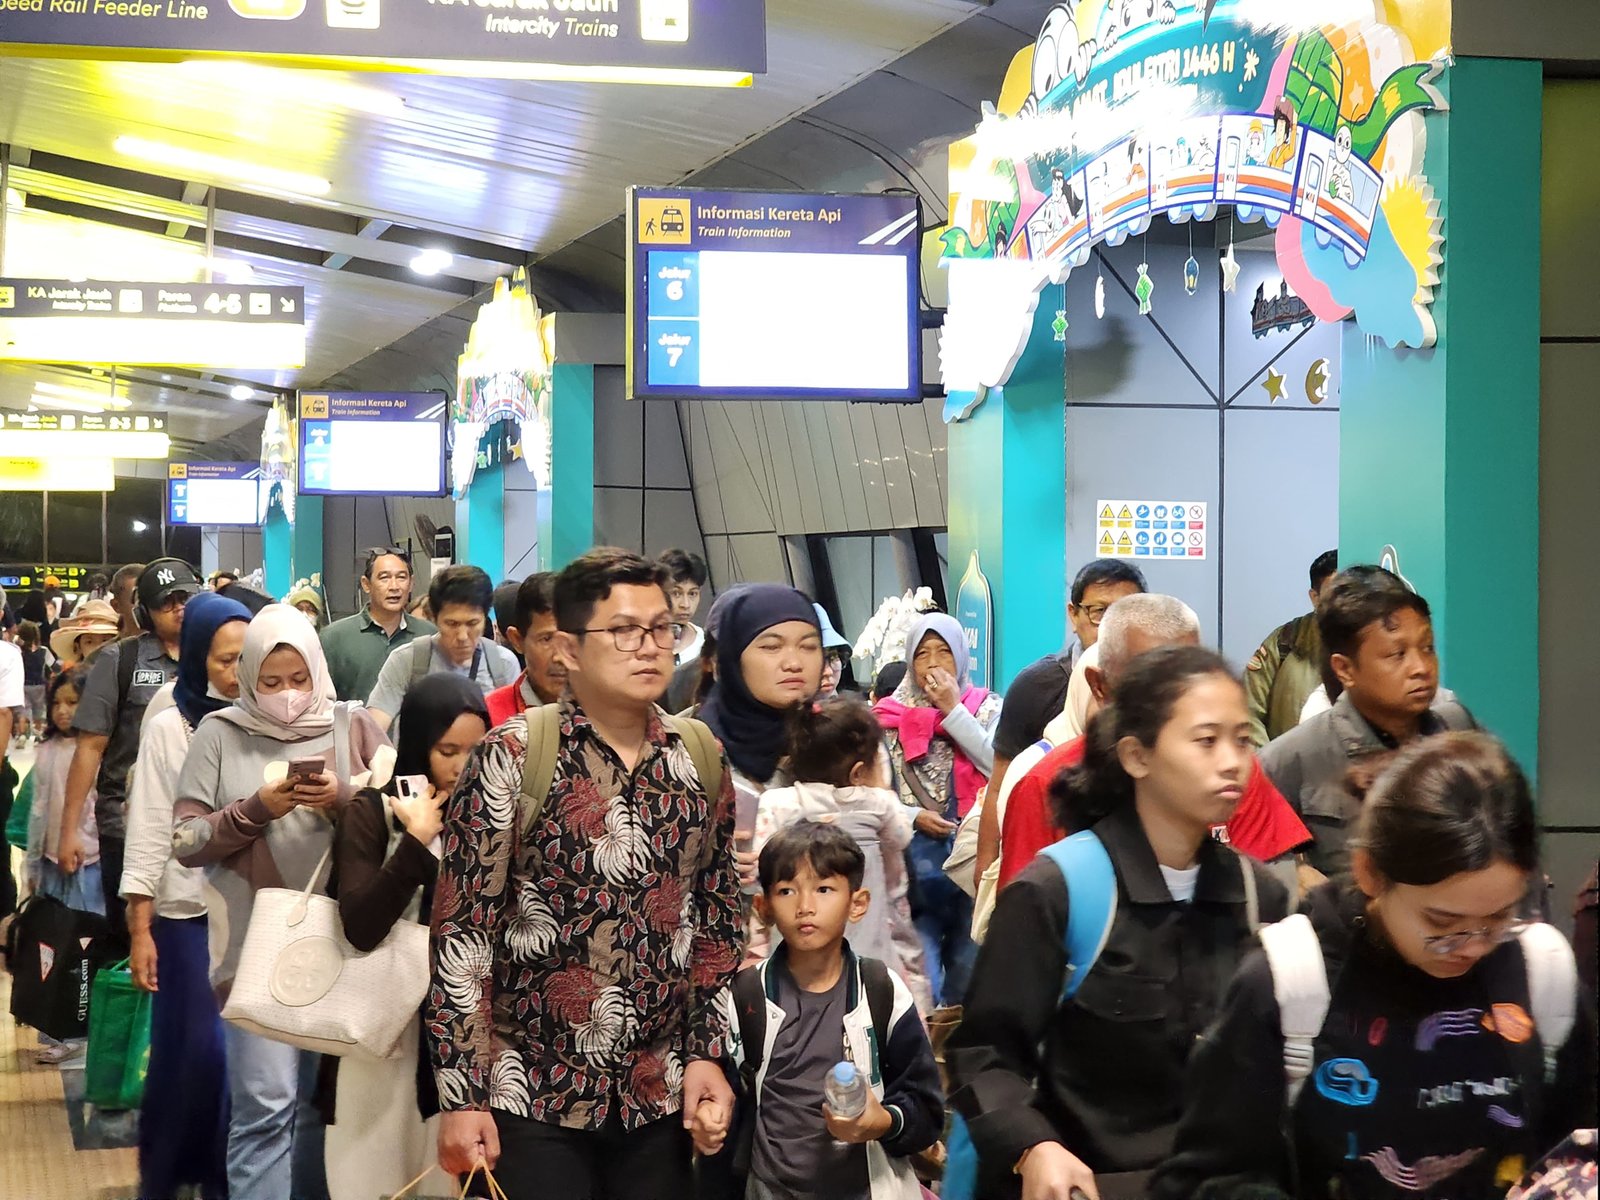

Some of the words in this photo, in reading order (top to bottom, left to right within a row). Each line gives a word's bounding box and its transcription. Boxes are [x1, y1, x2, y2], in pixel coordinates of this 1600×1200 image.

[50, 0, 88, 14] Rail
[94, 0, 162, 18] Feeder
[166, 1, 209, 20] Line
[485, 14, 560, 39] Intercity
[565, 18, 619, 38] Trains
[1182, 41, 1220, 79] 1446
[1222, 40, 1236, 73] H
[697, 206, 765, 220] Informasi
[768, 207, 814, 222] Kereta
[818, 208, 841, 224] Api
[697, 226, 726, 237] Train
[728, 227, 791, 239] Information
[28, 286, 47, 298] KA
[666, 280, 684, 301] 6
[666, 347, 684, 368] 7
[331, 399, 367, 407] Informasi
[368, 399, 393, 407] Kereta
[394, 400, 407, 409] Api
[78, 958, 89, 1022] GUESS.com
